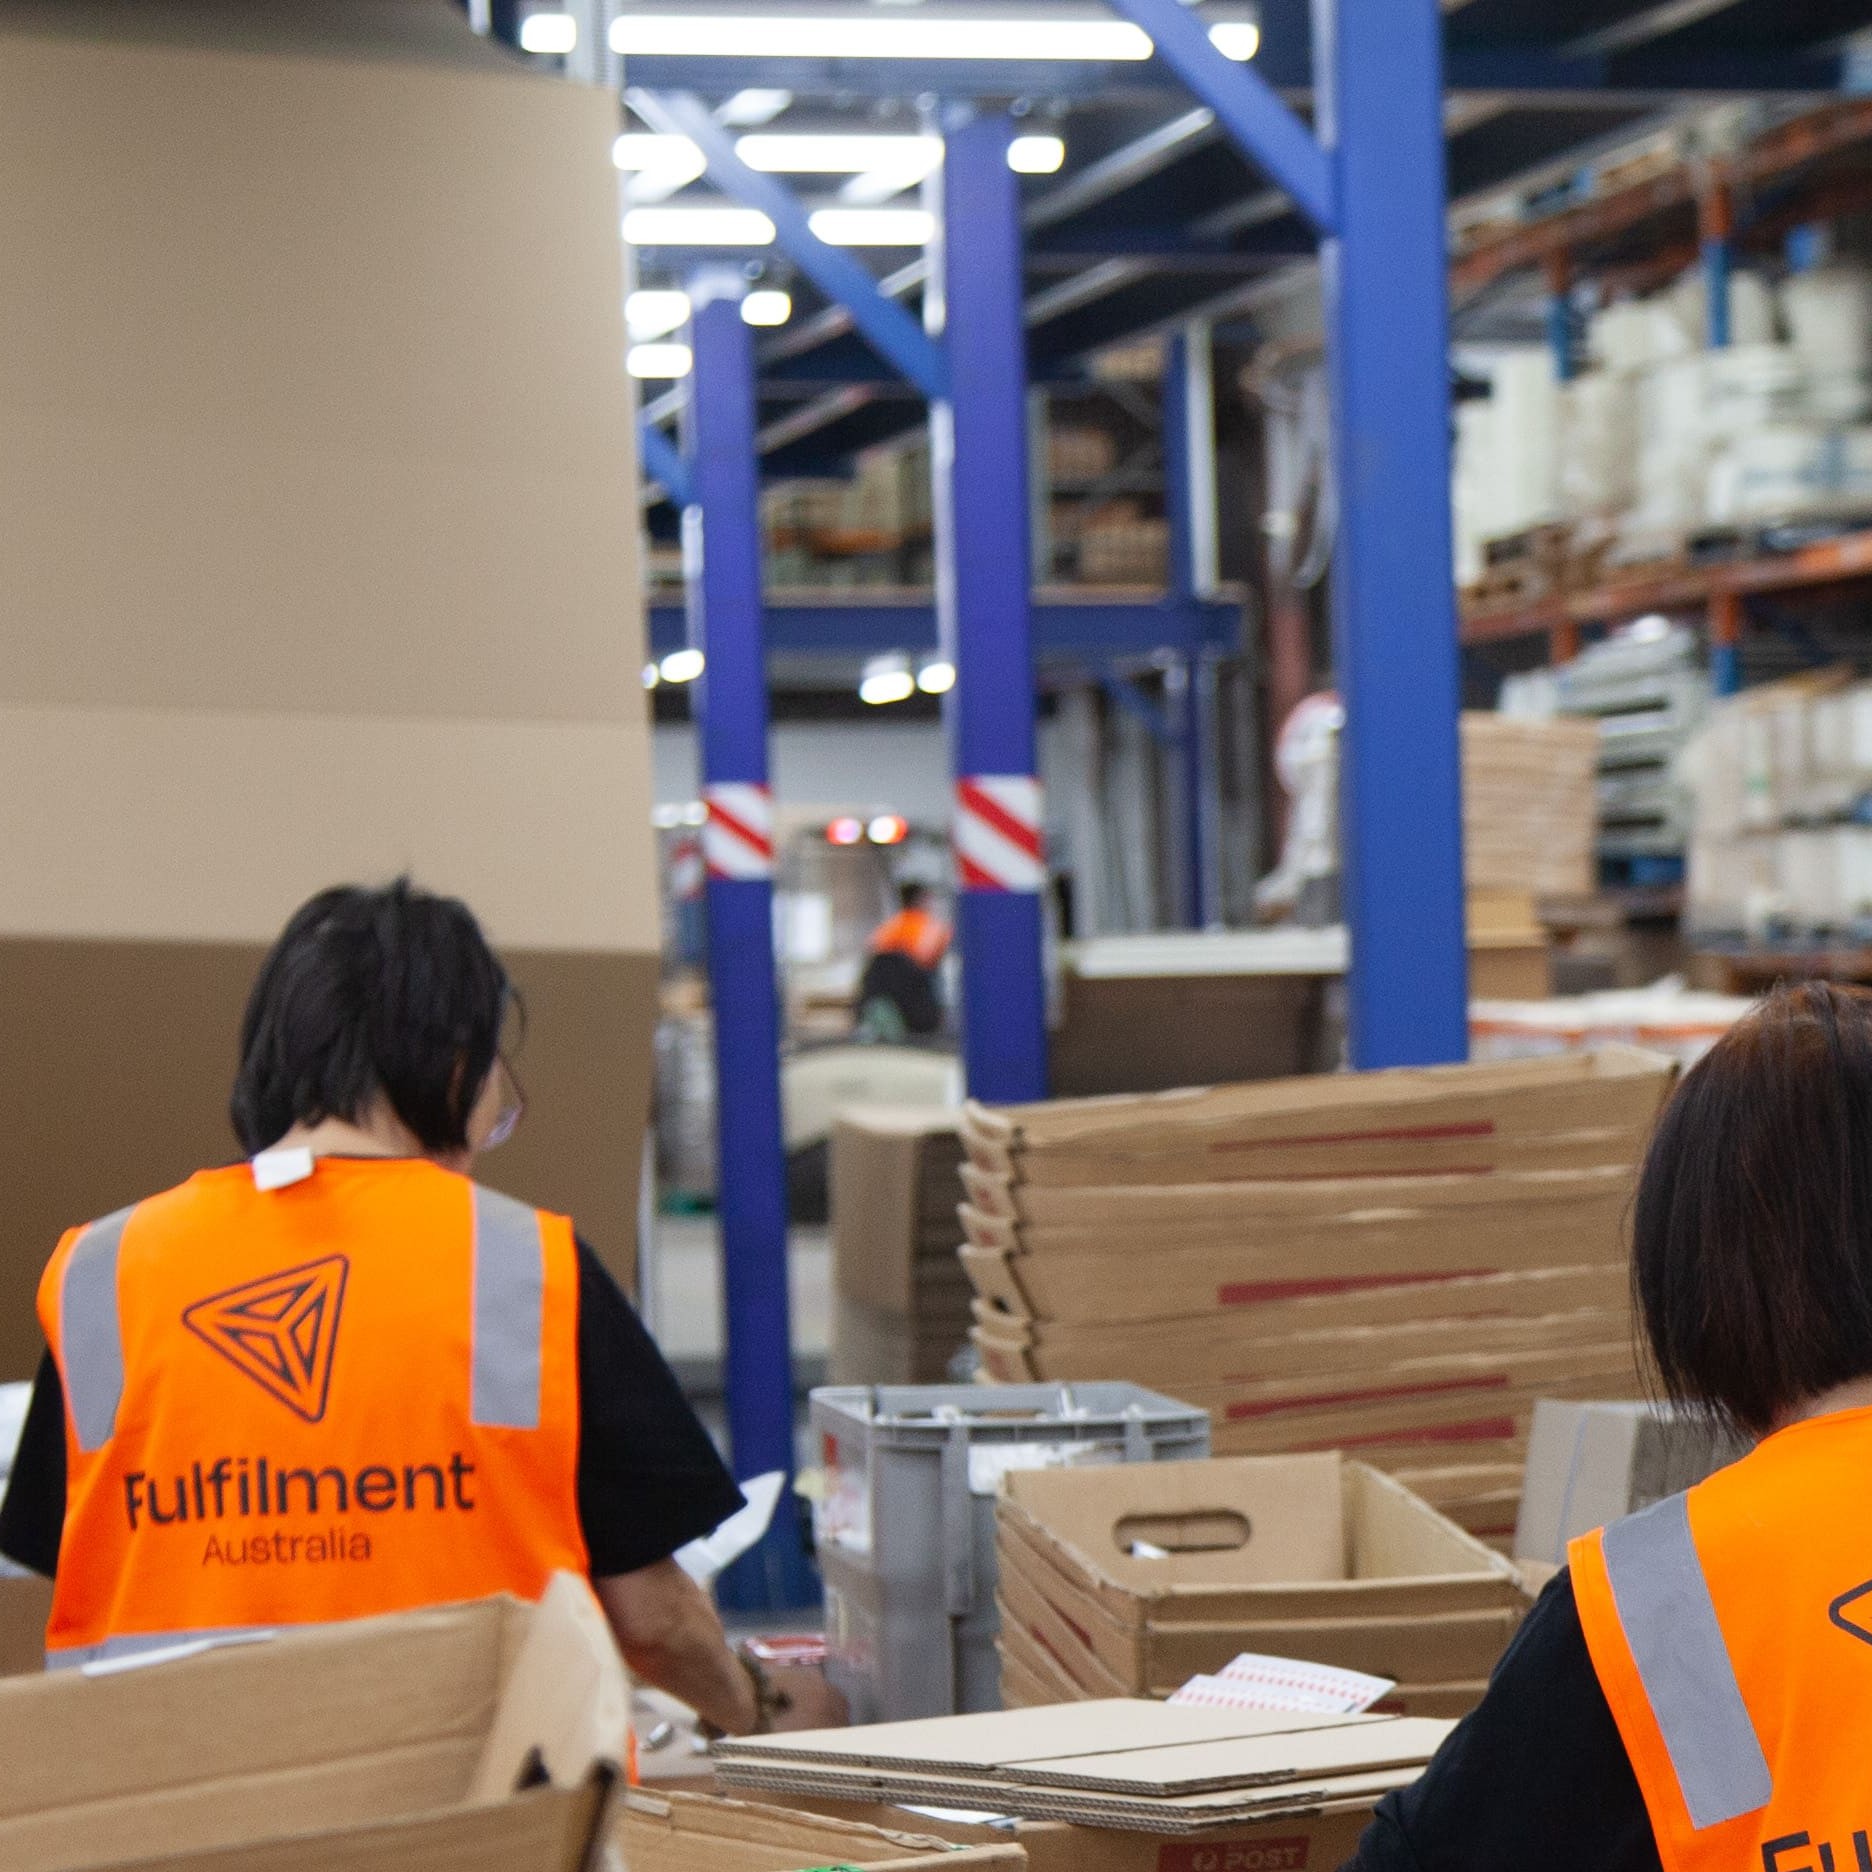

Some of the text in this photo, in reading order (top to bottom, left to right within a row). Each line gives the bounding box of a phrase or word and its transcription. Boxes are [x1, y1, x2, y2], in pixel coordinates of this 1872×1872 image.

[123, 1452, 475, 1531] Fulfilment
[202, 1527, 372, 1566] Australia
[1223, 1847, 1299, 1871] POST
